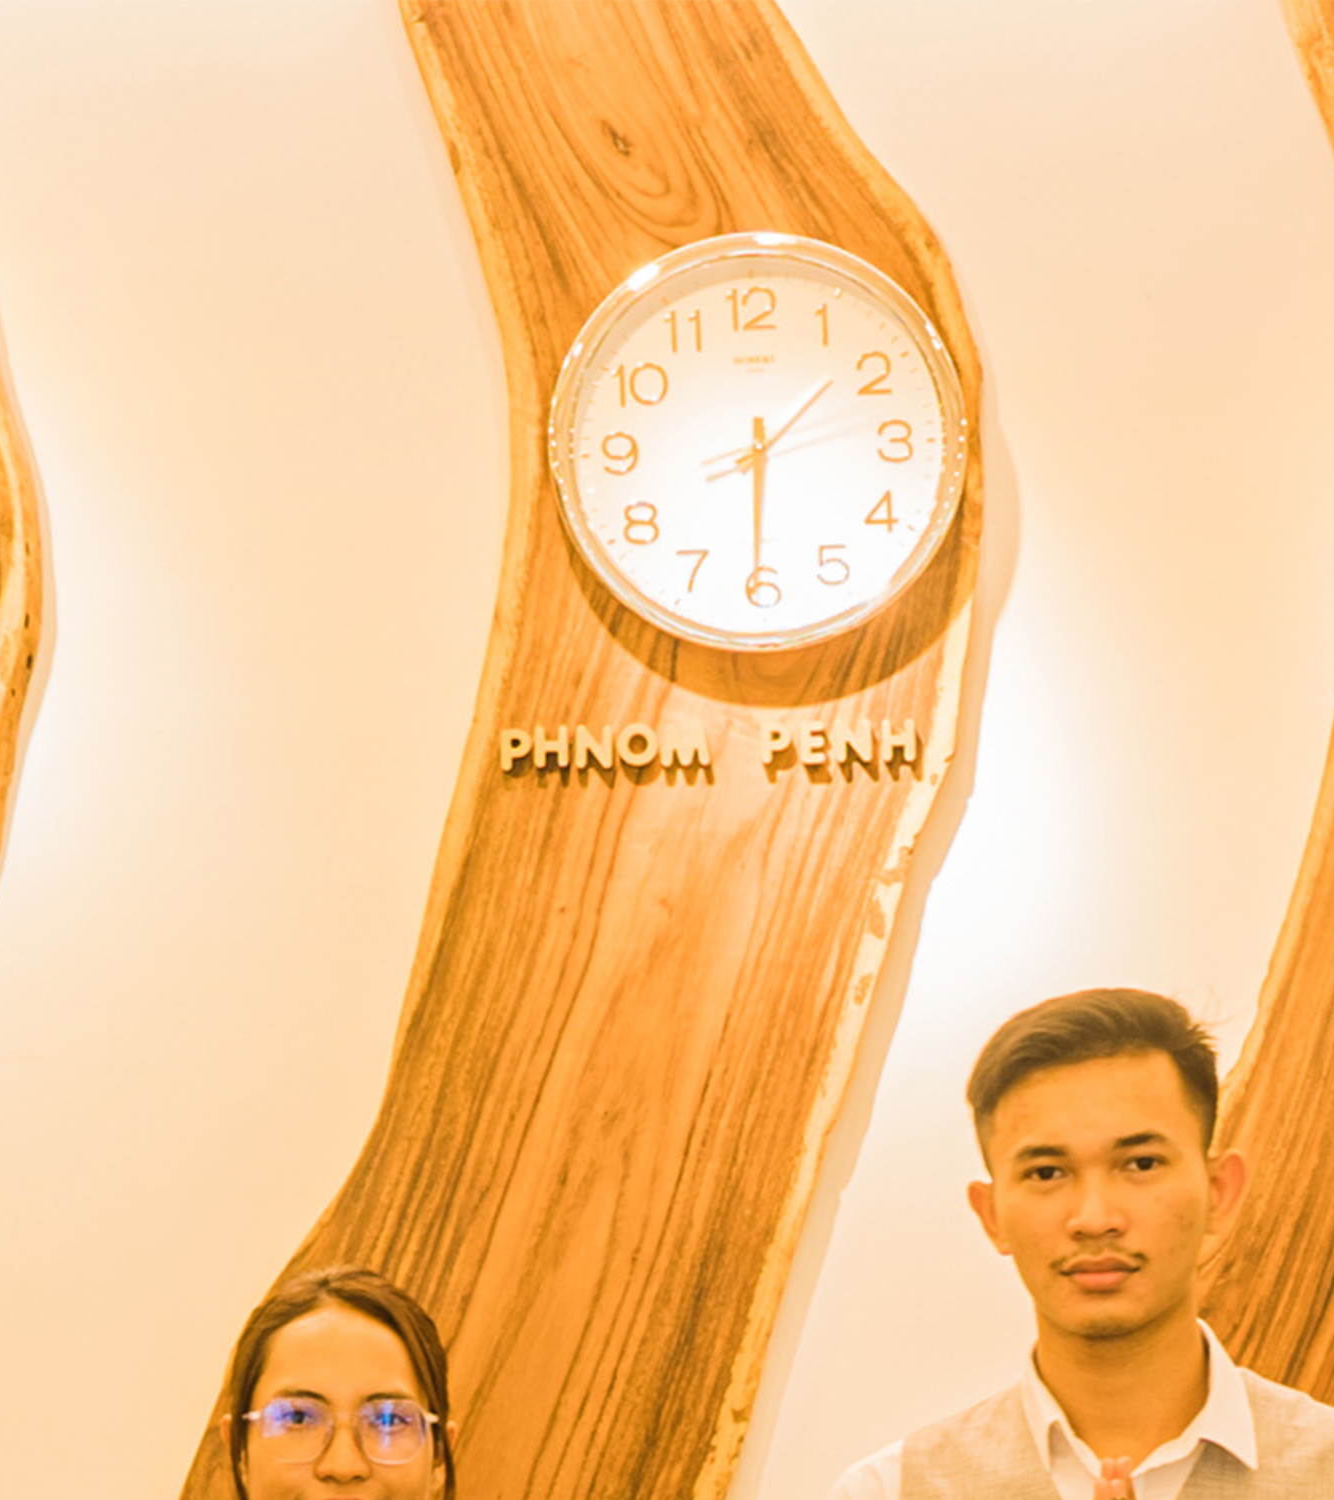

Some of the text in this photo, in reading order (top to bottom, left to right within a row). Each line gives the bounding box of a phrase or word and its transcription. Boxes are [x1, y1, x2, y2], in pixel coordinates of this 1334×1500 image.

[726, 286, 777, 331] 12
[815, 304, 830, 346] 1
[664, 310, 701, 353] 11
[613, 362, 668, 407] 10
[857, 351, 893, 395] 2
[602, 433, 639, 475] 9
[877, 420, 913, 463] 3
[624, 502, 659, 544] 8
[865, 490, 898, 532] 4
[676, 550, 708, 593] 7
[746, 566, 781, 608] 6
[817, 545, 850, 586] 5
[500, 719, 917, 770] PHNOM PENH
